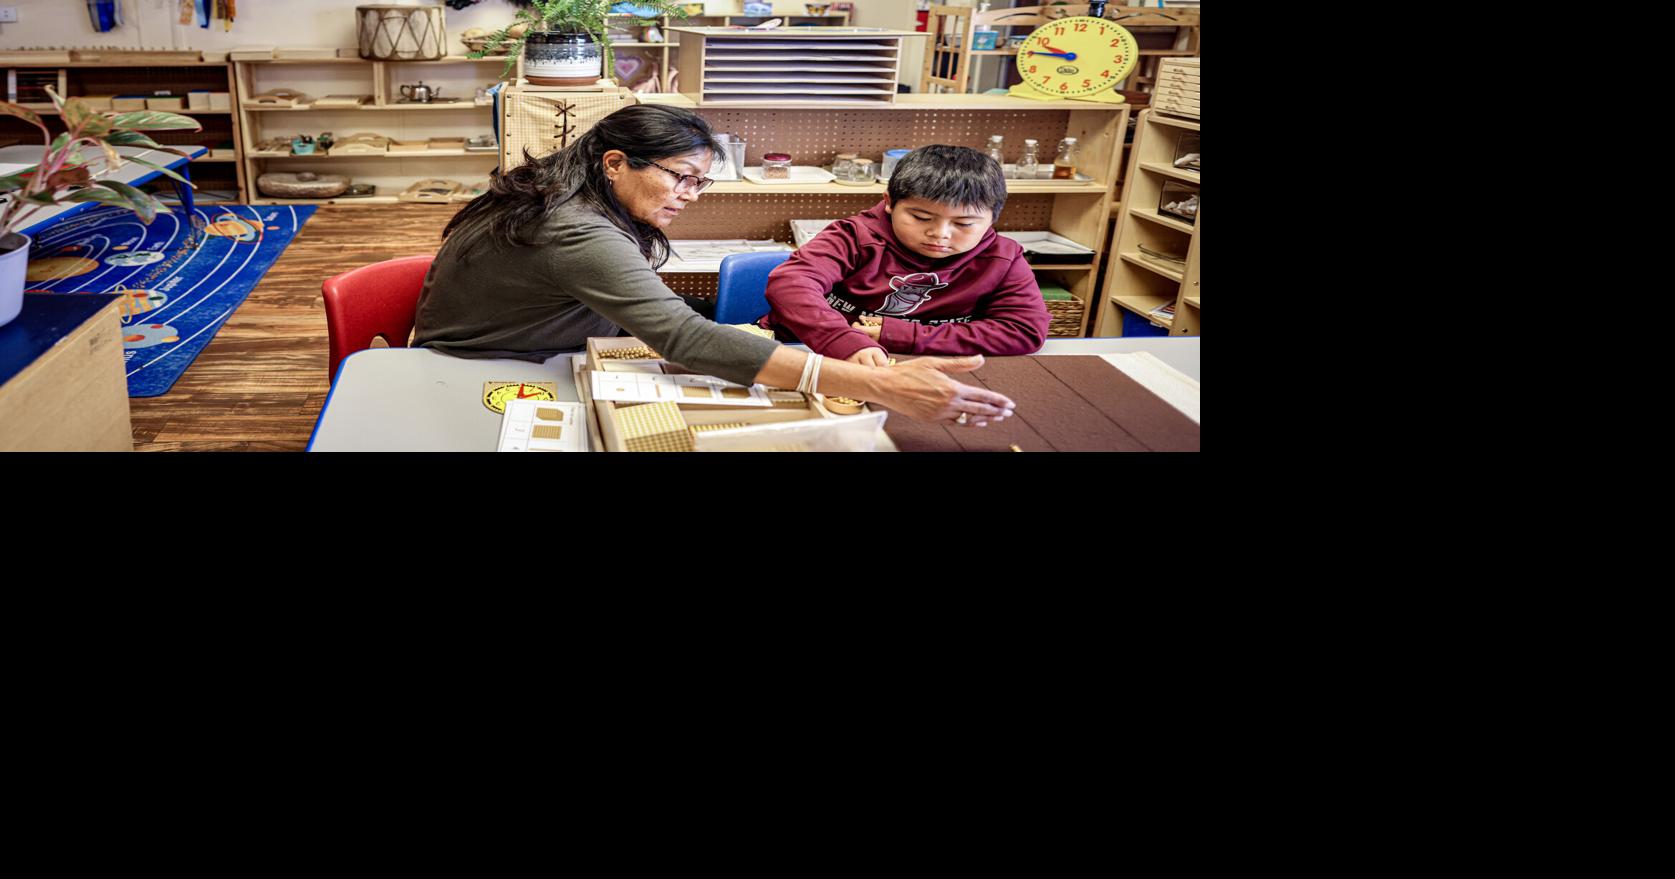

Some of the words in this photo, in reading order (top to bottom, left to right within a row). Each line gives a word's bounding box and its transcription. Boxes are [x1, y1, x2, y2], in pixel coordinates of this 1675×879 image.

[1055, 27, 1064, 35] 11
[1074, 23, 1088, 32] 12
[1100, 27, 1105, 35] 1
[1037, 37, 1050, 46] 10
[1110, 39, 1119, 47] 2
[1114, 55, 1122, 64] 3
[1029, 65, 1037, 73] 8
[1101, 70, 1109, 78] 4
[1043, 76, 1051, 84] 7
[1082, 80, 1091, 88] 5
[1060, 82, 1068, 90] 6
[827, 293, 855, 312] NEW
